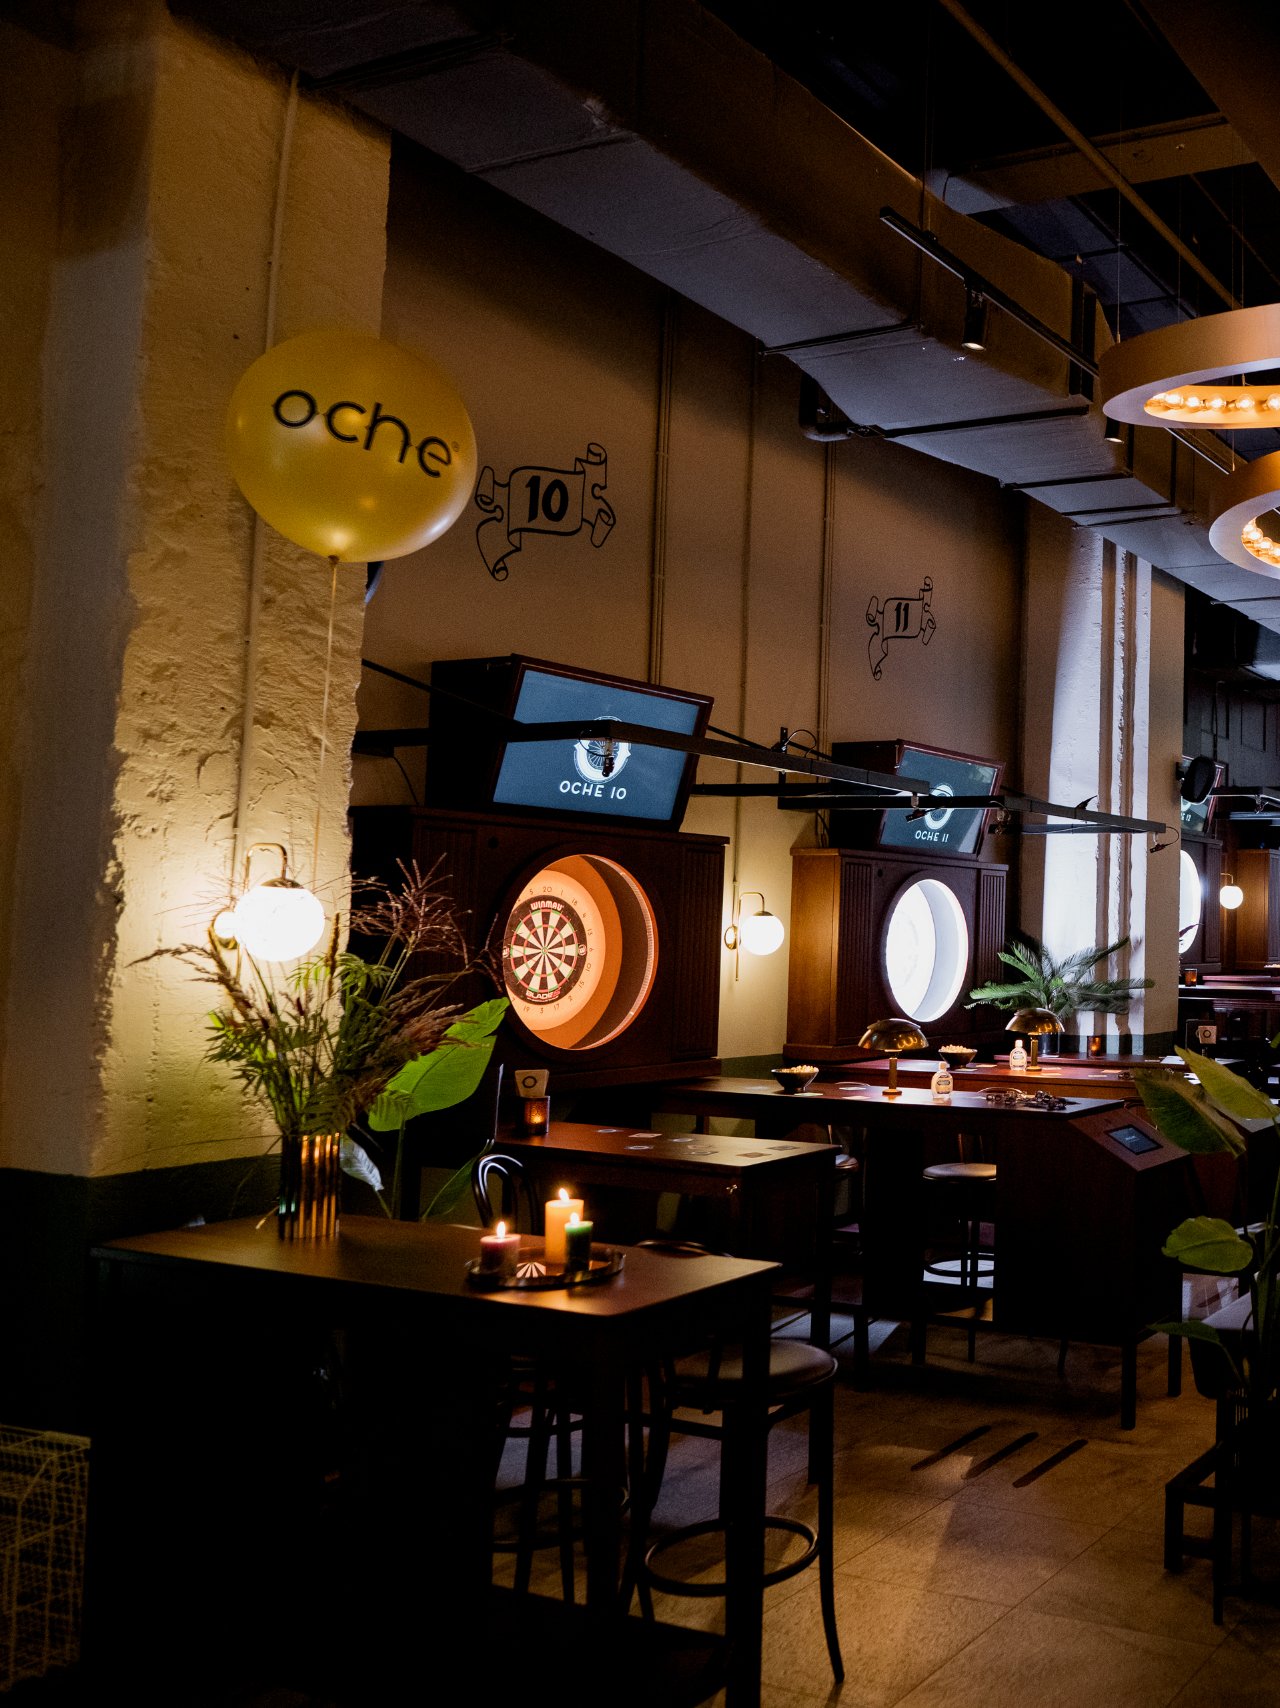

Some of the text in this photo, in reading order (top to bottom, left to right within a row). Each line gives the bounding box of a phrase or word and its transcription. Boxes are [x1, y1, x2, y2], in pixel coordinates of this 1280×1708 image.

[525, 475, 569, 523] 10
[894, 601, 910, 633] 11
[559, 780, 627, 800] OCHE 10
[914, 830, 940, 842] OCHE
[530, 900, 563, 912] WINMAU
